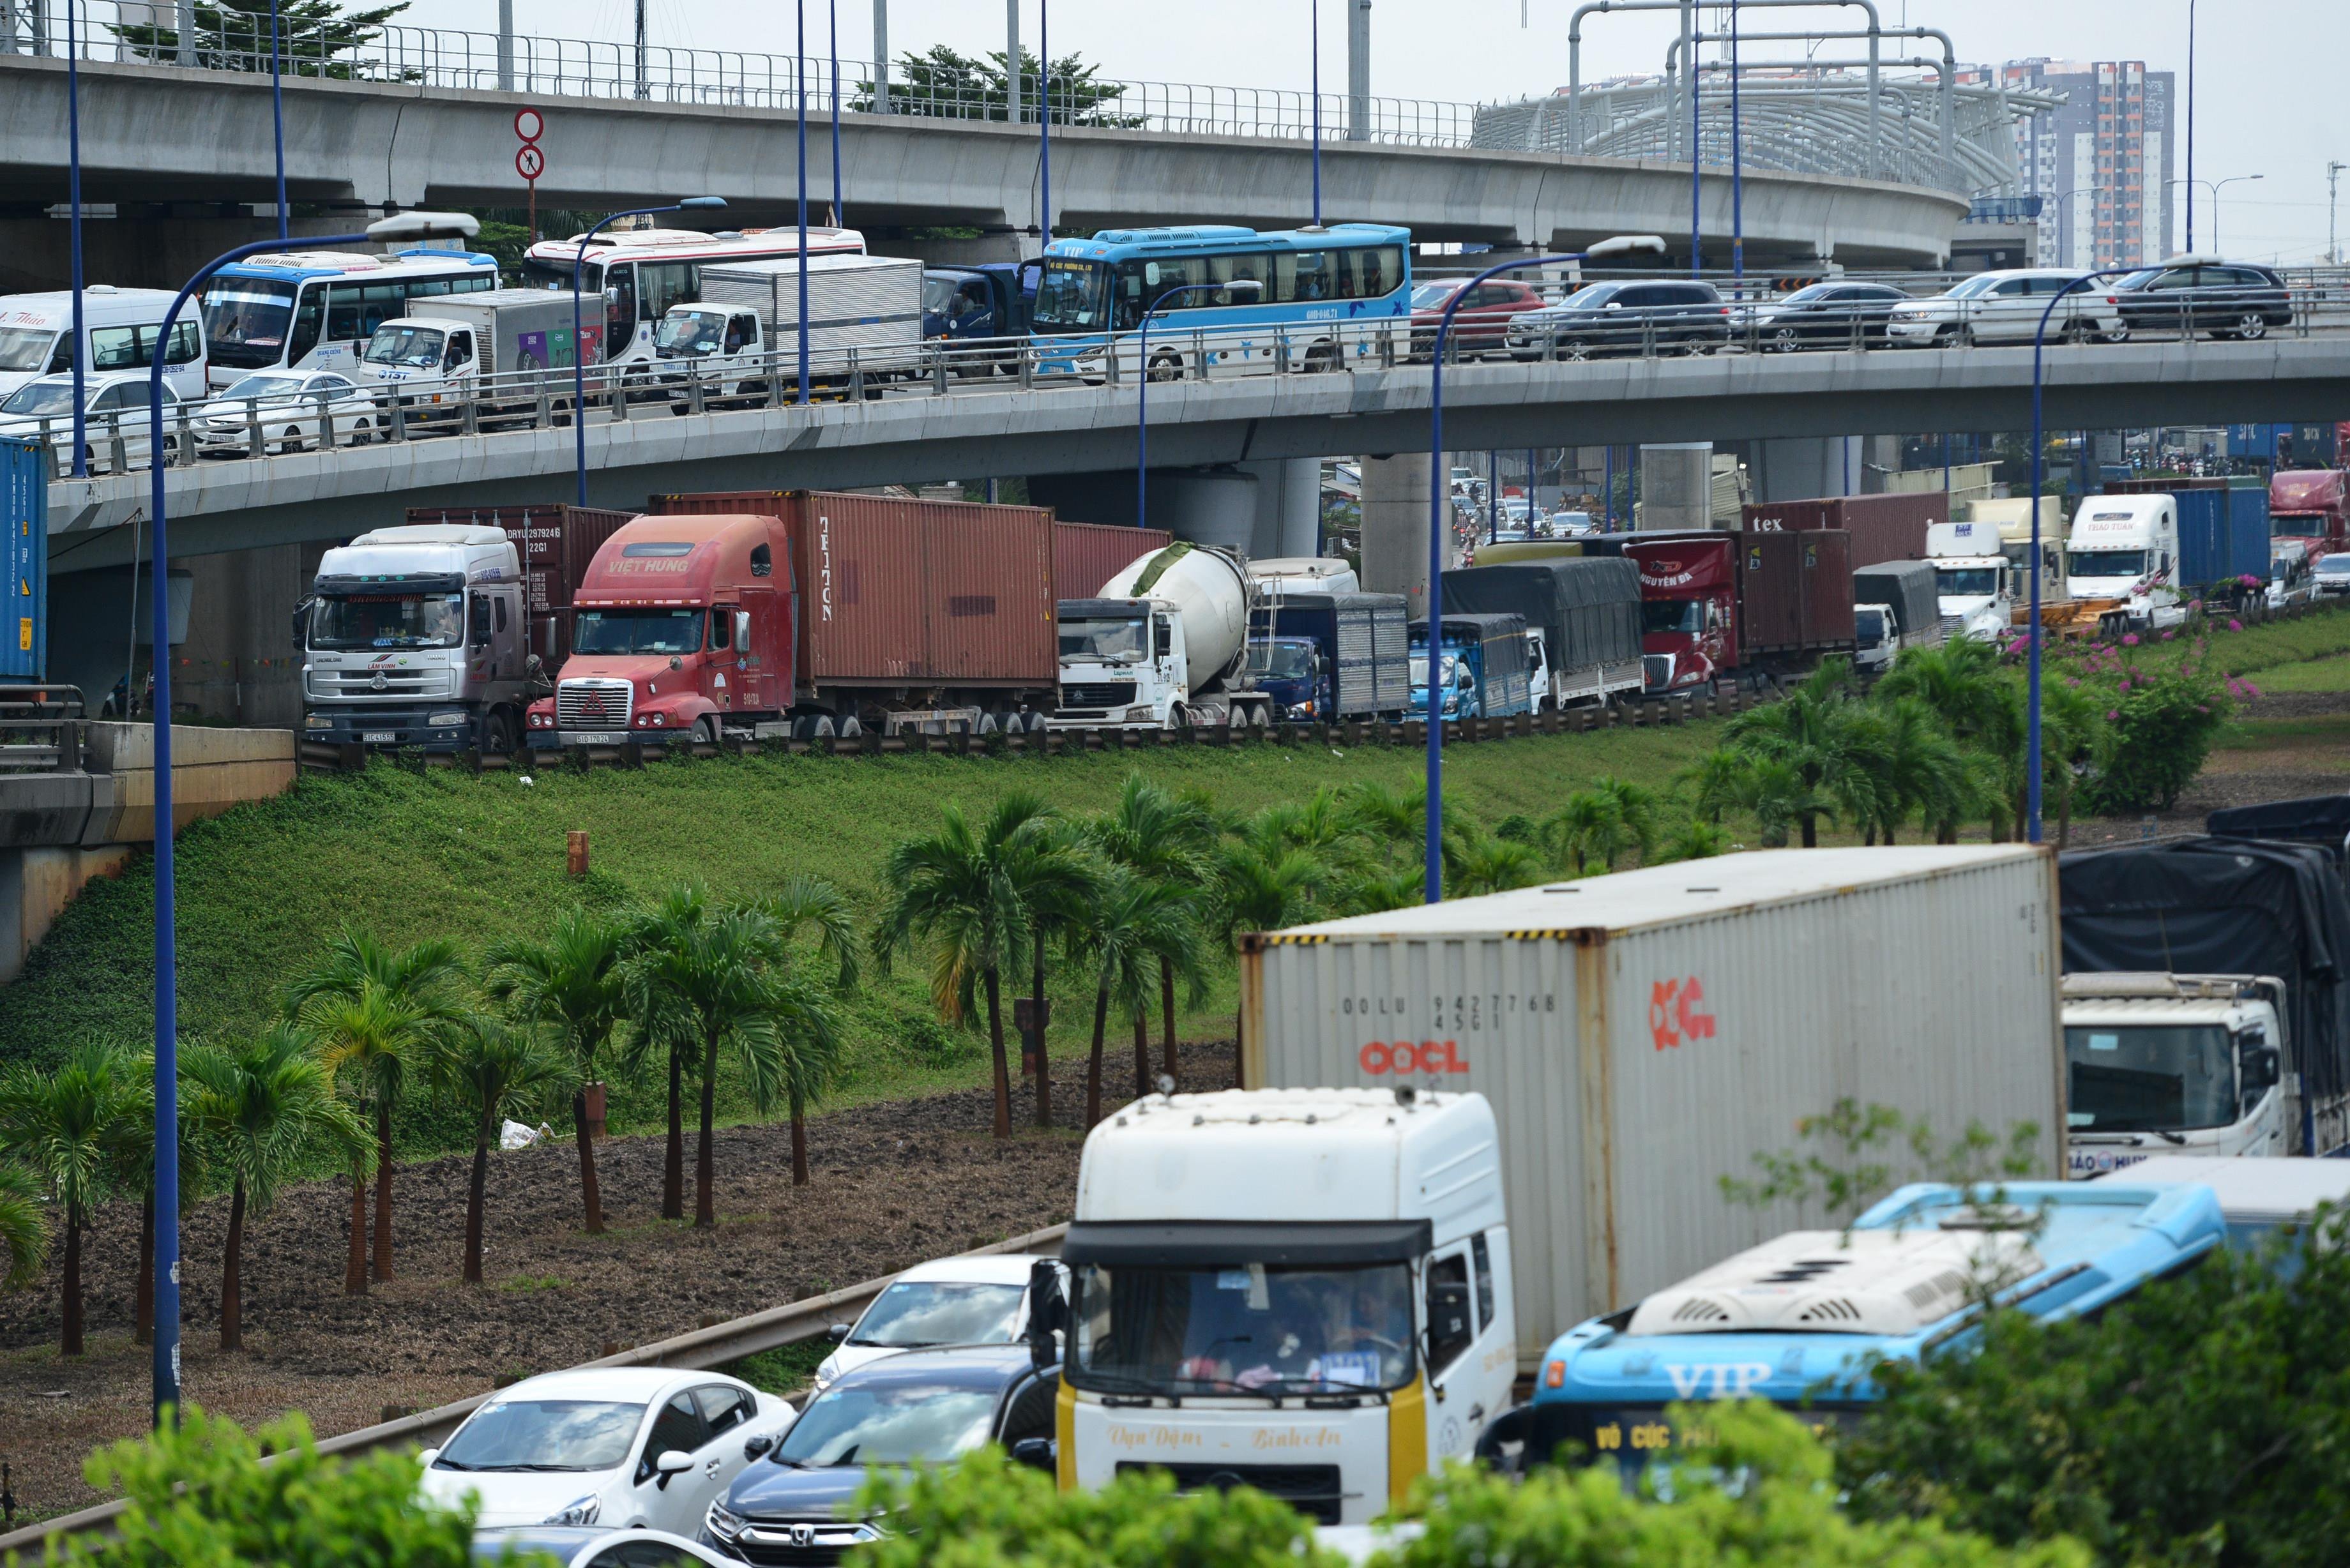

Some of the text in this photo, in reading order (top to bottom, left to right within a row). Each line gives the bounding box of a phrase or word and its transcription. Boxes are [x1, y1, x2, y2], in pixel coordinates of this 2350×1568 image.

[1753, 516, 1784, 531] tex
[529, 528, 554, 538] 297924
[529, 542, 547, 552] 22G1
[609, 559, 688, 575] VIỆT HƯNG
[1343, 997, 1406, 1015] OOLU
[1434, 1014, 1499, 1031] 45G1
[1359, 1040, 1470, 1076] OOCL
[1664, 1362, 1771, 1399] VIP
